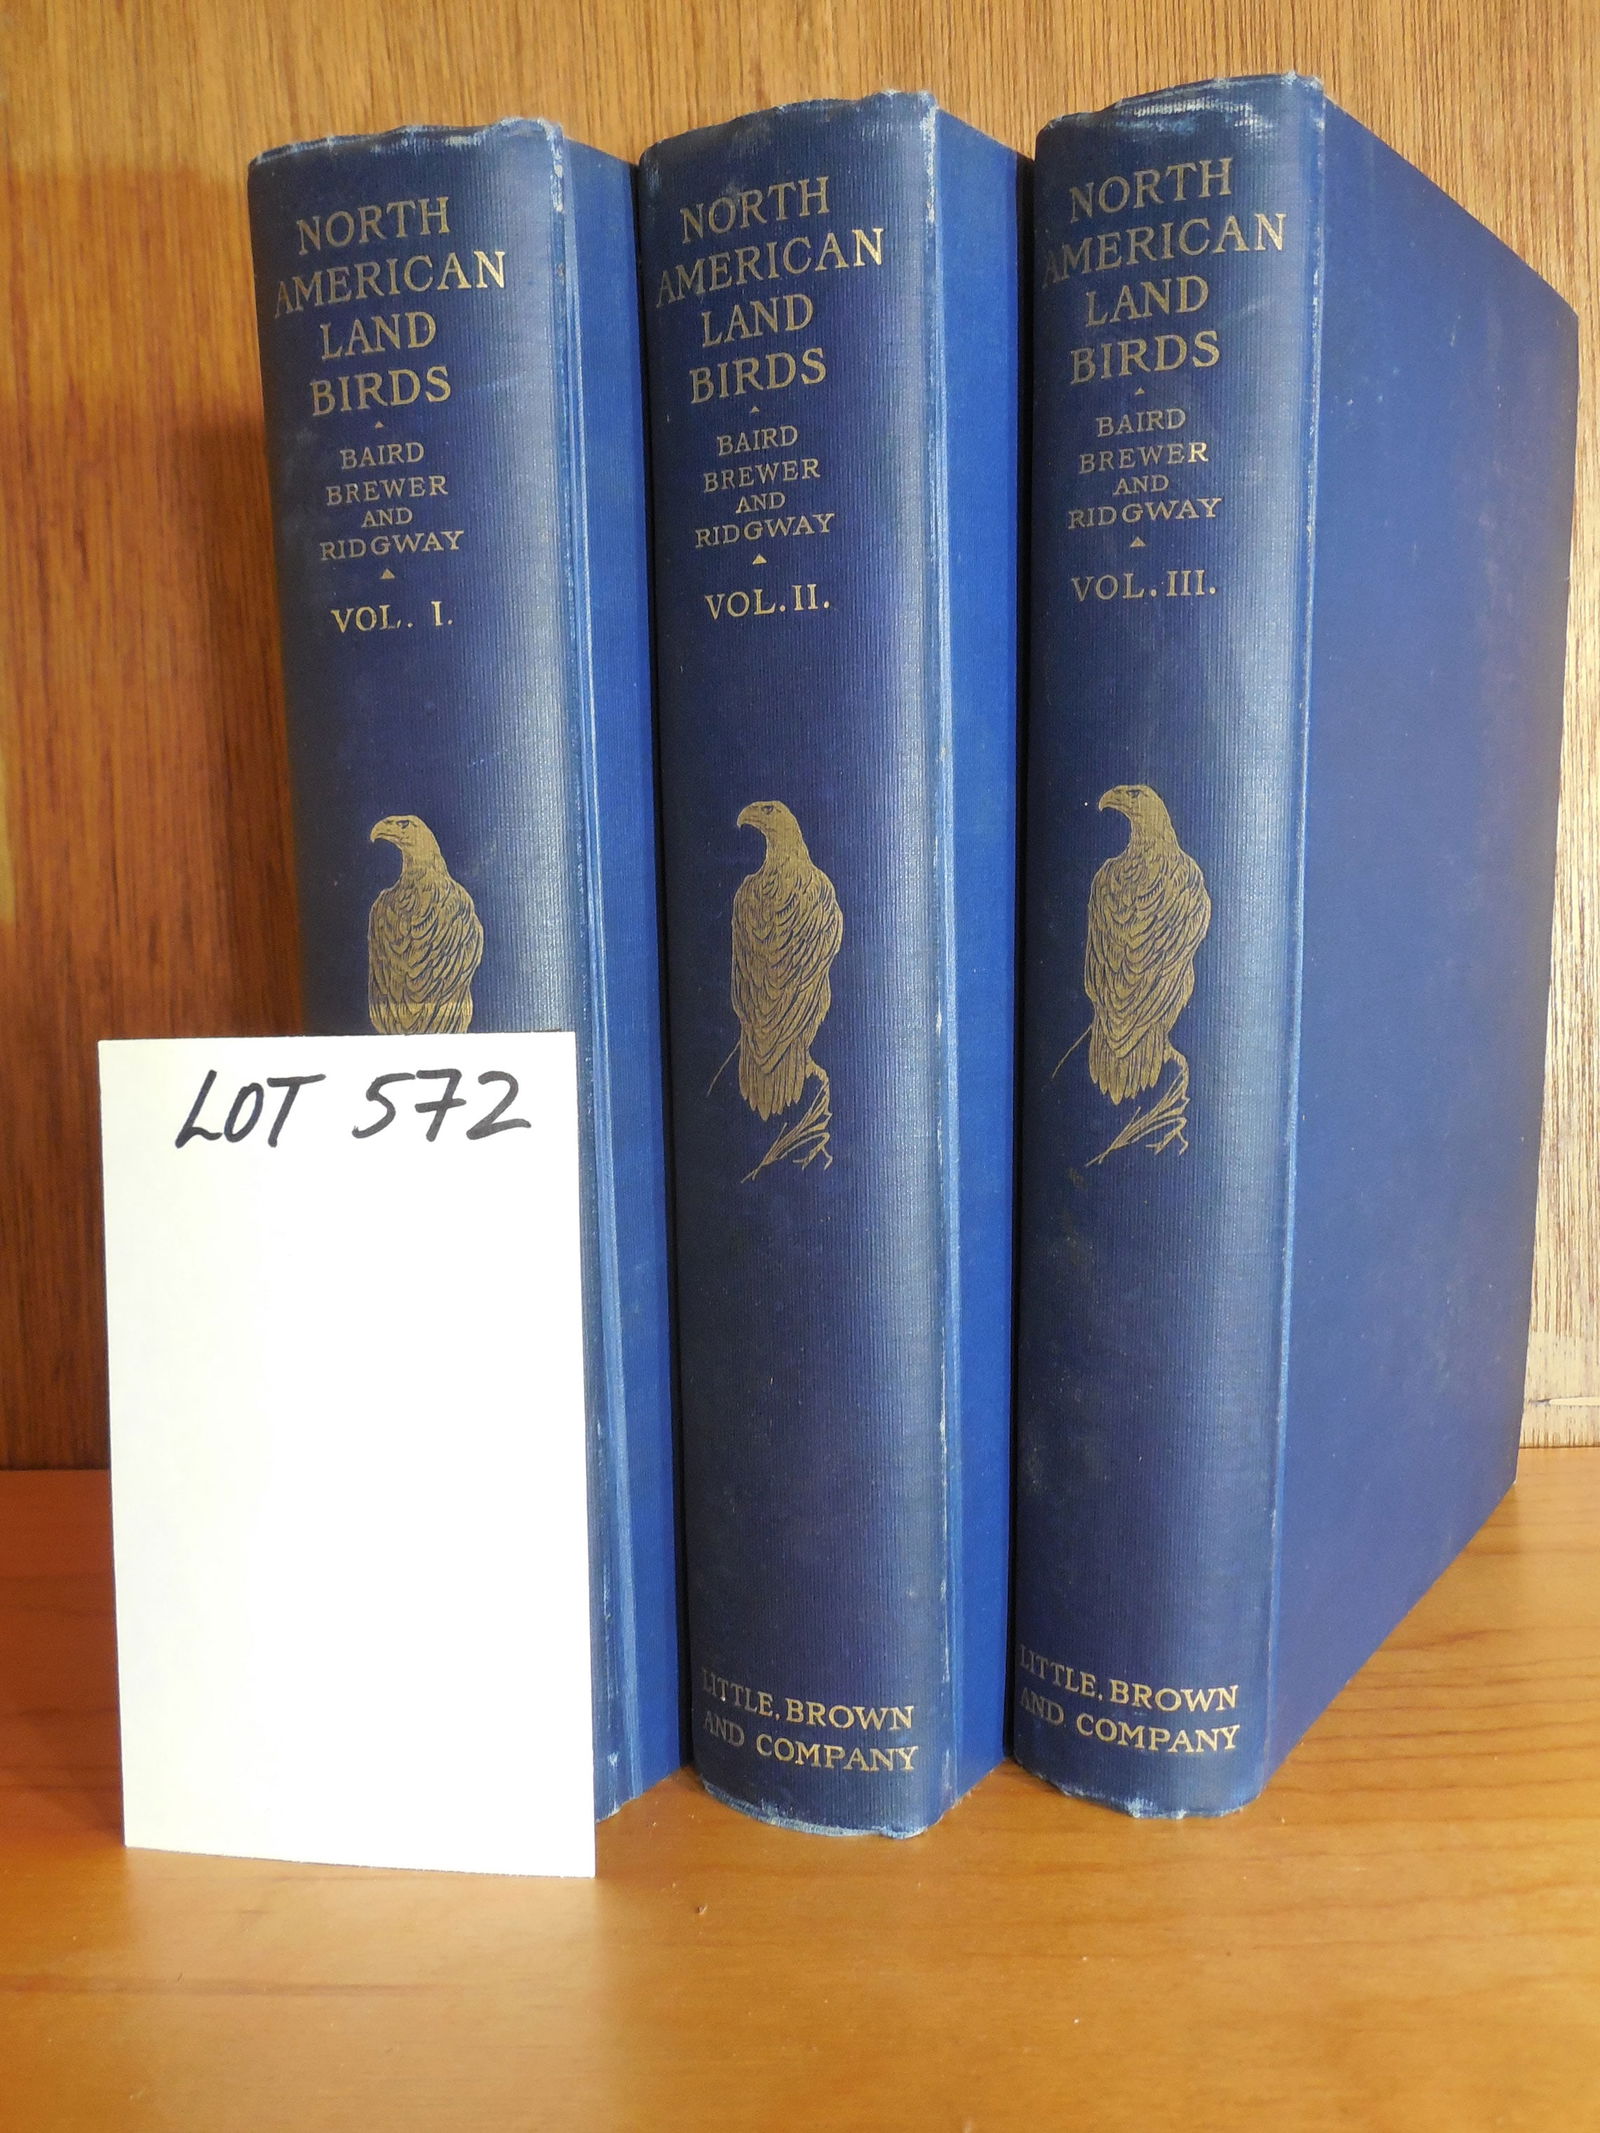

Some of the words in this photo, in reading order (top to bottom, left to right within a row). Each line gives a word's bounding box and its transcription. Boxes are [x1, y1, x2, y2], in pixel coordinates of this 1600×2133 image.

[680, 176, 831, 244] NORTH
[1069, 158, 1233, 224] NORTH
[296, 197, 450, 255] NORTH
[656, 228, 884, 308] AMERICAN
[1043, 213, 1286, 288] AMERICAN
[274, 251, 506, 319] AMERICAN
[1085, 275, 1209, 328] LAND
[320, 311, 437, 361] LAND
[701, 294, 814, 348] LAND
[690, 347, 827, 404] BIRDS
[1070, 330, 1221, 385] BIRDS
[310, 366, 452, 416] BIRDS
[717, 425, 798, 456] BAIRD
[1097, 408, 1186, 437] BAIRD
[340, 441, 425, 470] BAIRD
[703, 458, 821, 493] BREWER
[1079, 442, 1209, 474] BREWER
[327, 475, 449, 506] BREWER
[735, 492, 786, 514] AND
[1113, 475, 1169, 495] AND
[361, 508, 413, 529] AND
[695, 513, 835, 548] RIDGWAY
[1068, 498, 1222, 529] RIDGWAY
[320, 530, 464, 561] RIDGWAY
[331, 604, 413, 633] VOL.
[174, 1069, 326, 1148] LOT
[351, 1069, 531, 1142] 572
[786, 1698, 915, 1731] BROWN
[1110, 1681, 1239, 1712] BROWN
[1020, 1686, 1065, 1725] AND
[1076, 1714, 1240, 1753] COMPANY
[703, 1710, 745, 1748] AND
[756, 1736, 918, 1772] COMPANY
